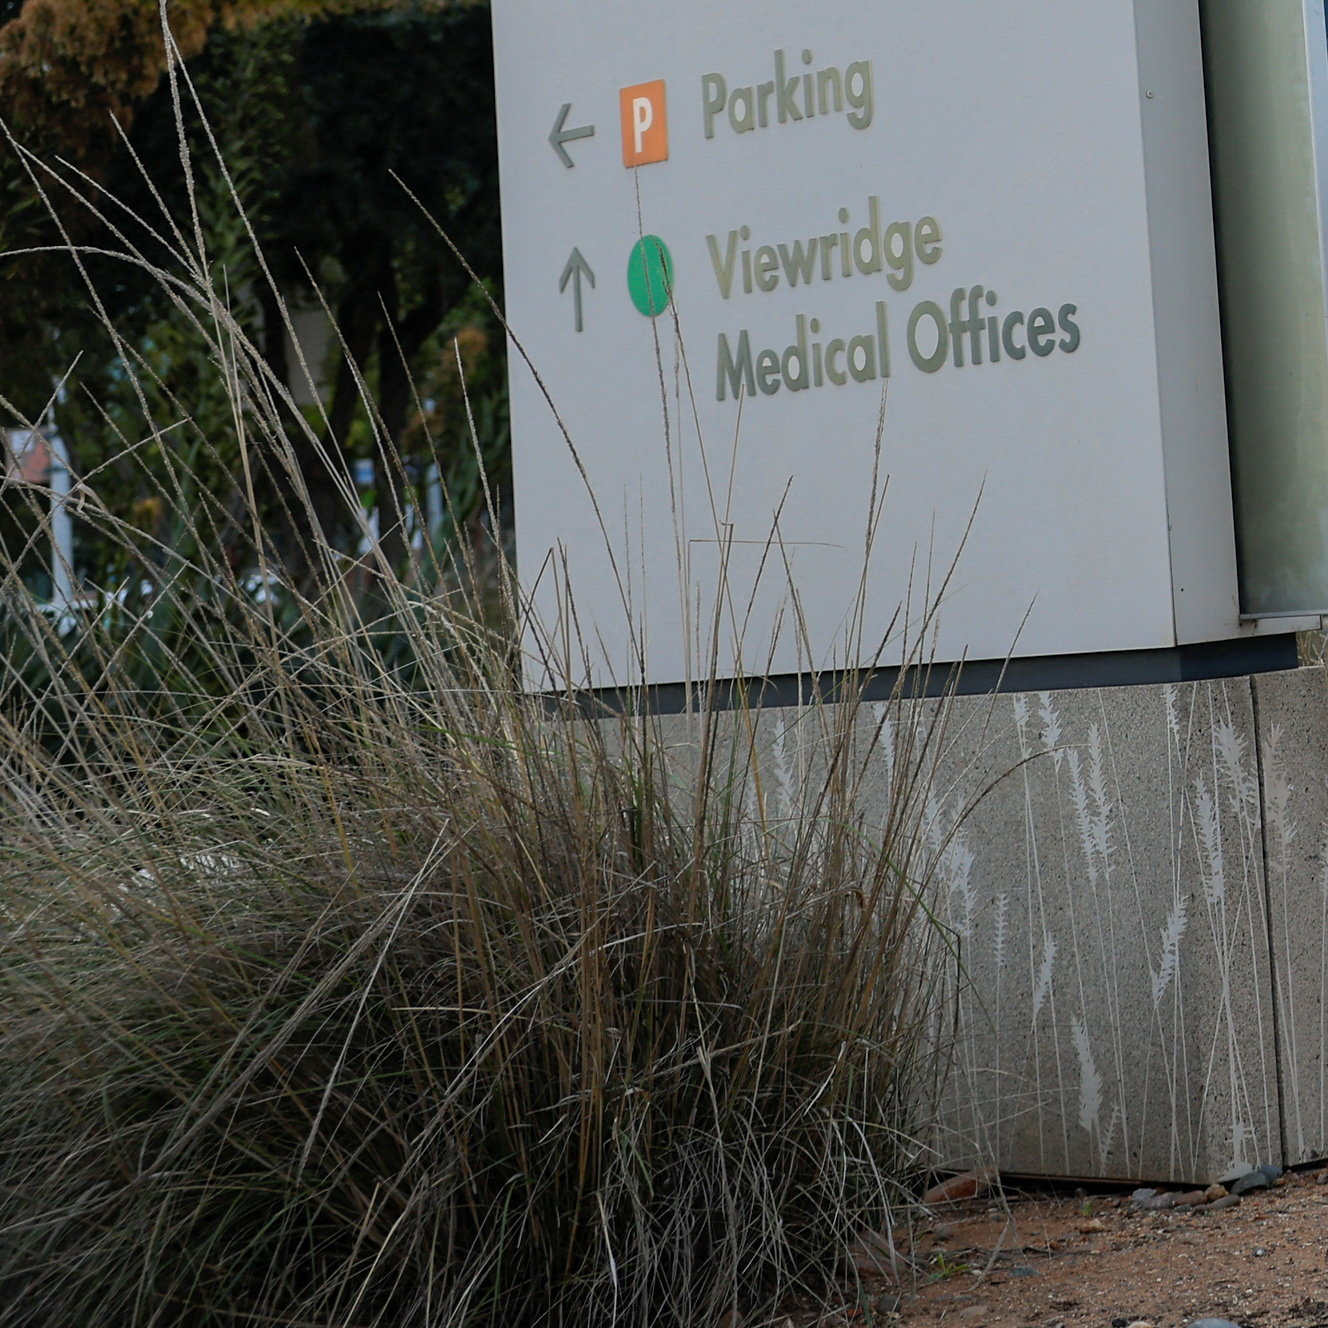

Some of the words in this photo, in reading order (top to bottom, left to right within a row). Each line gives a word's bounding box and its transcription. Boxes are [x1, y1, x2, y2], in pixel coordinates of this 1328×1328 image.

[632, 95, 654, 155] P
[700, 48, 873, 139] Parking
[705, 195, 943, 299] Viewridge
[714, 300, 891, 401] Medical
[906, 284, 1081, 374] Offices
